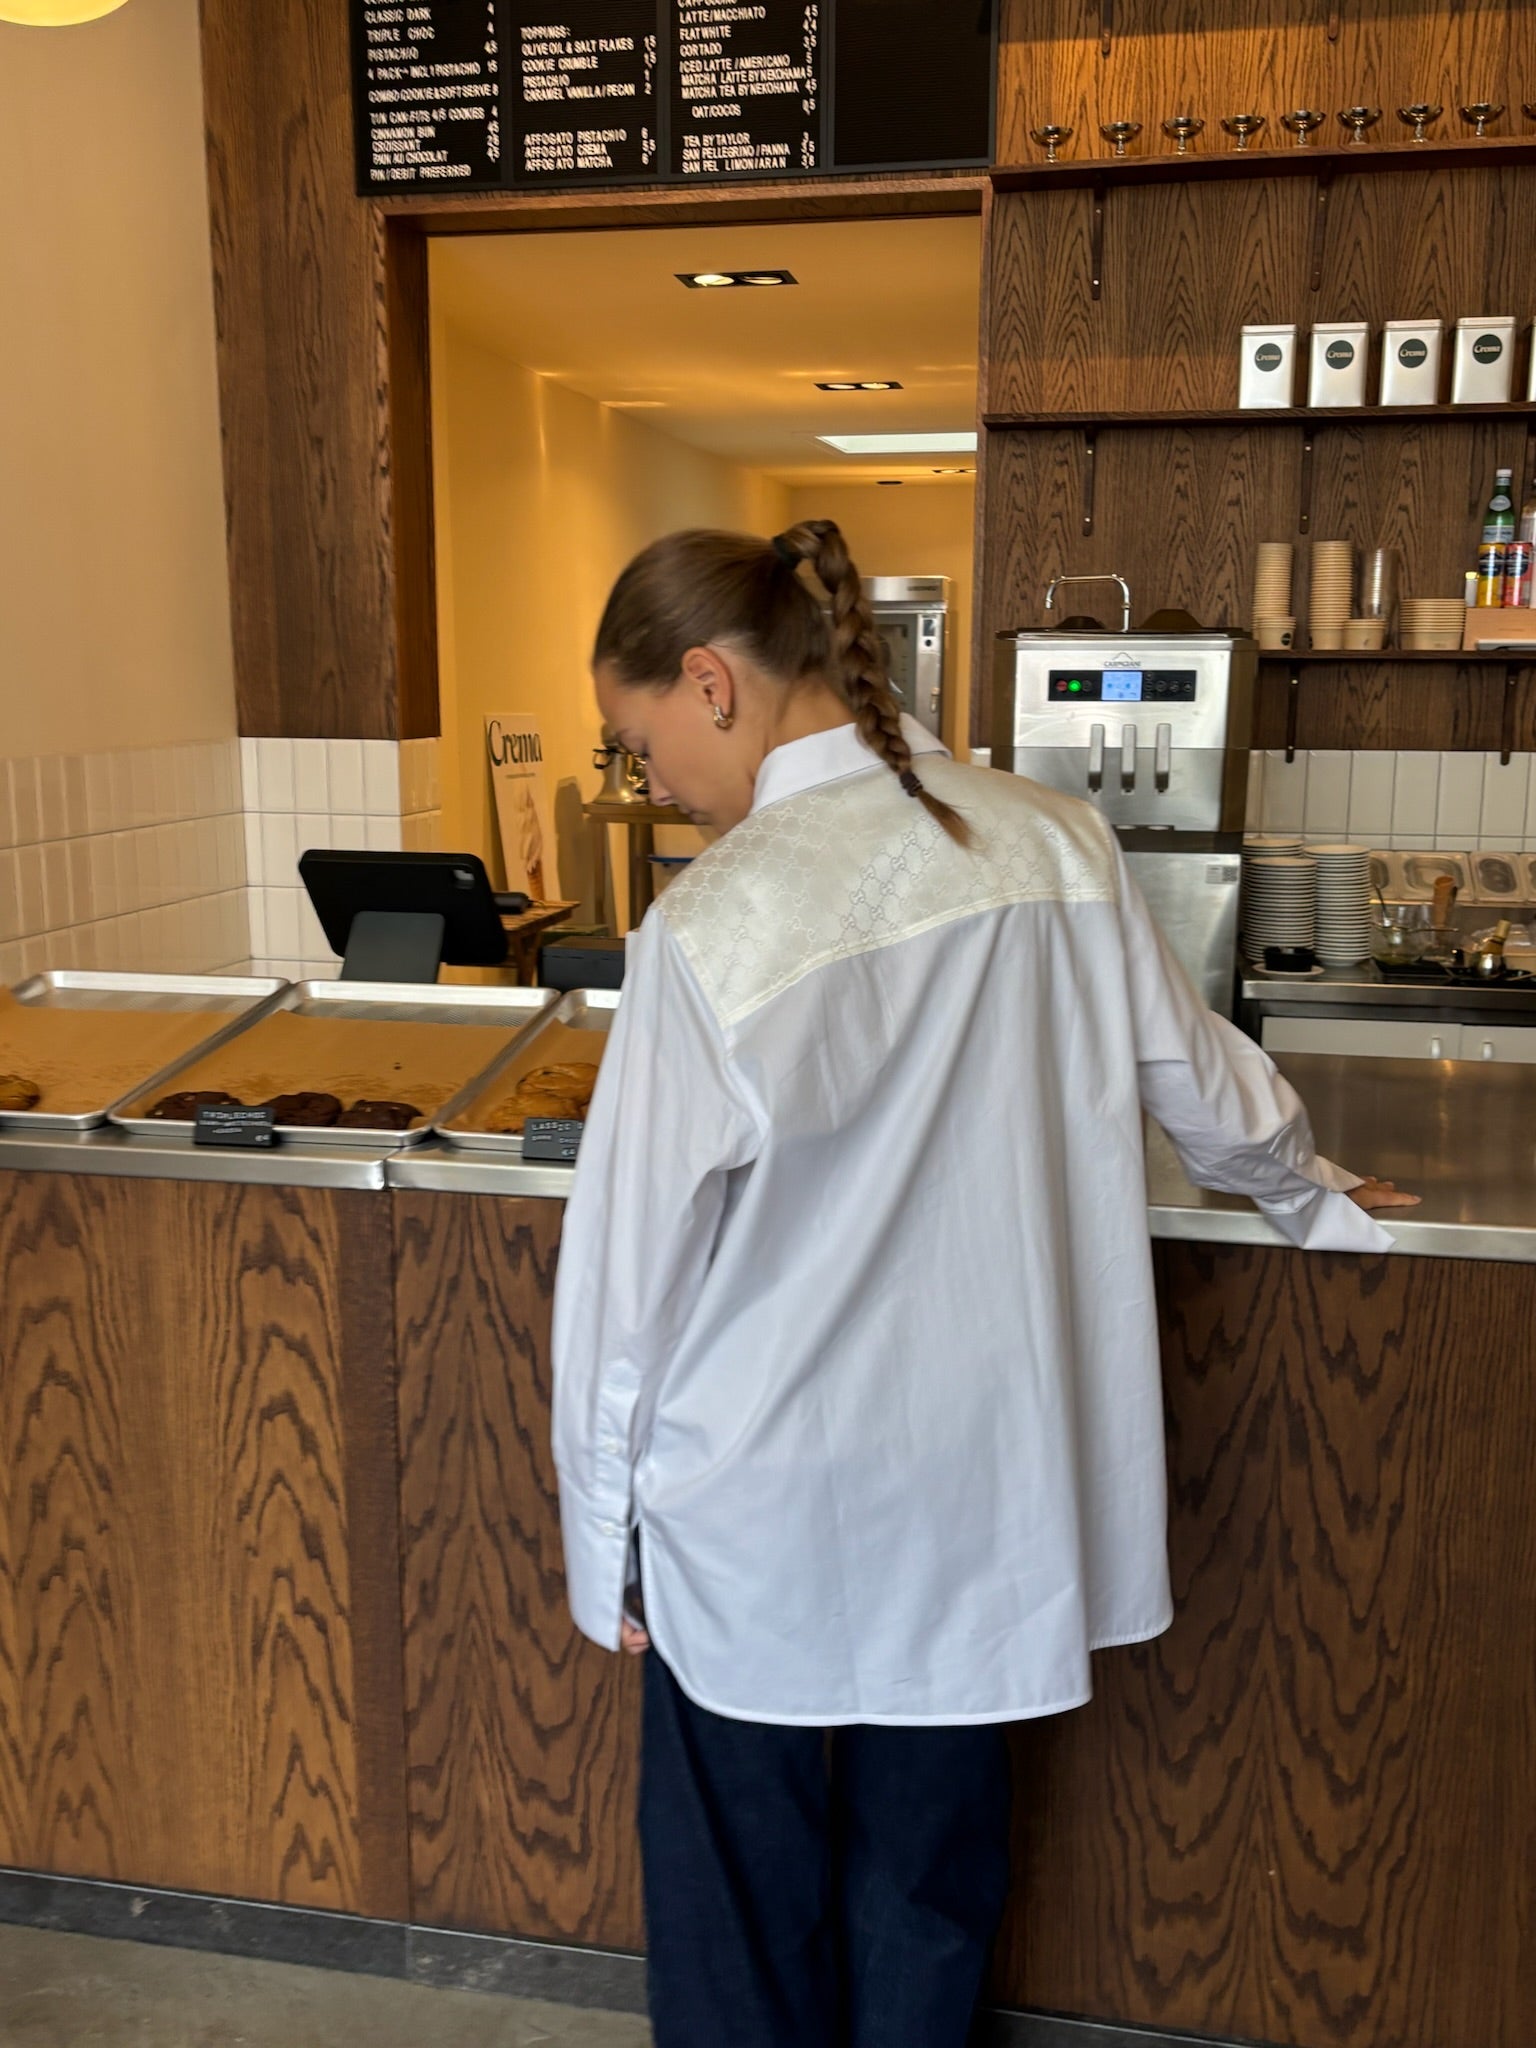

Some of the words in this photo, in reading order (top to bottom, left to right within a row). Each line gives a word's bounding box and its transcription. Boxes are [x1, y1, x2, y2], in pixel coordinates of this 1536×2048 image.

[368, 46, 418, 61] PISTACHIO
[680, 42, 722, 57] CORTADO
[523, 74, 571, 89] PISTACHIO
[577, 129, 627, 143] PISTACHIO
[488, 720, 543, 766] Crema
